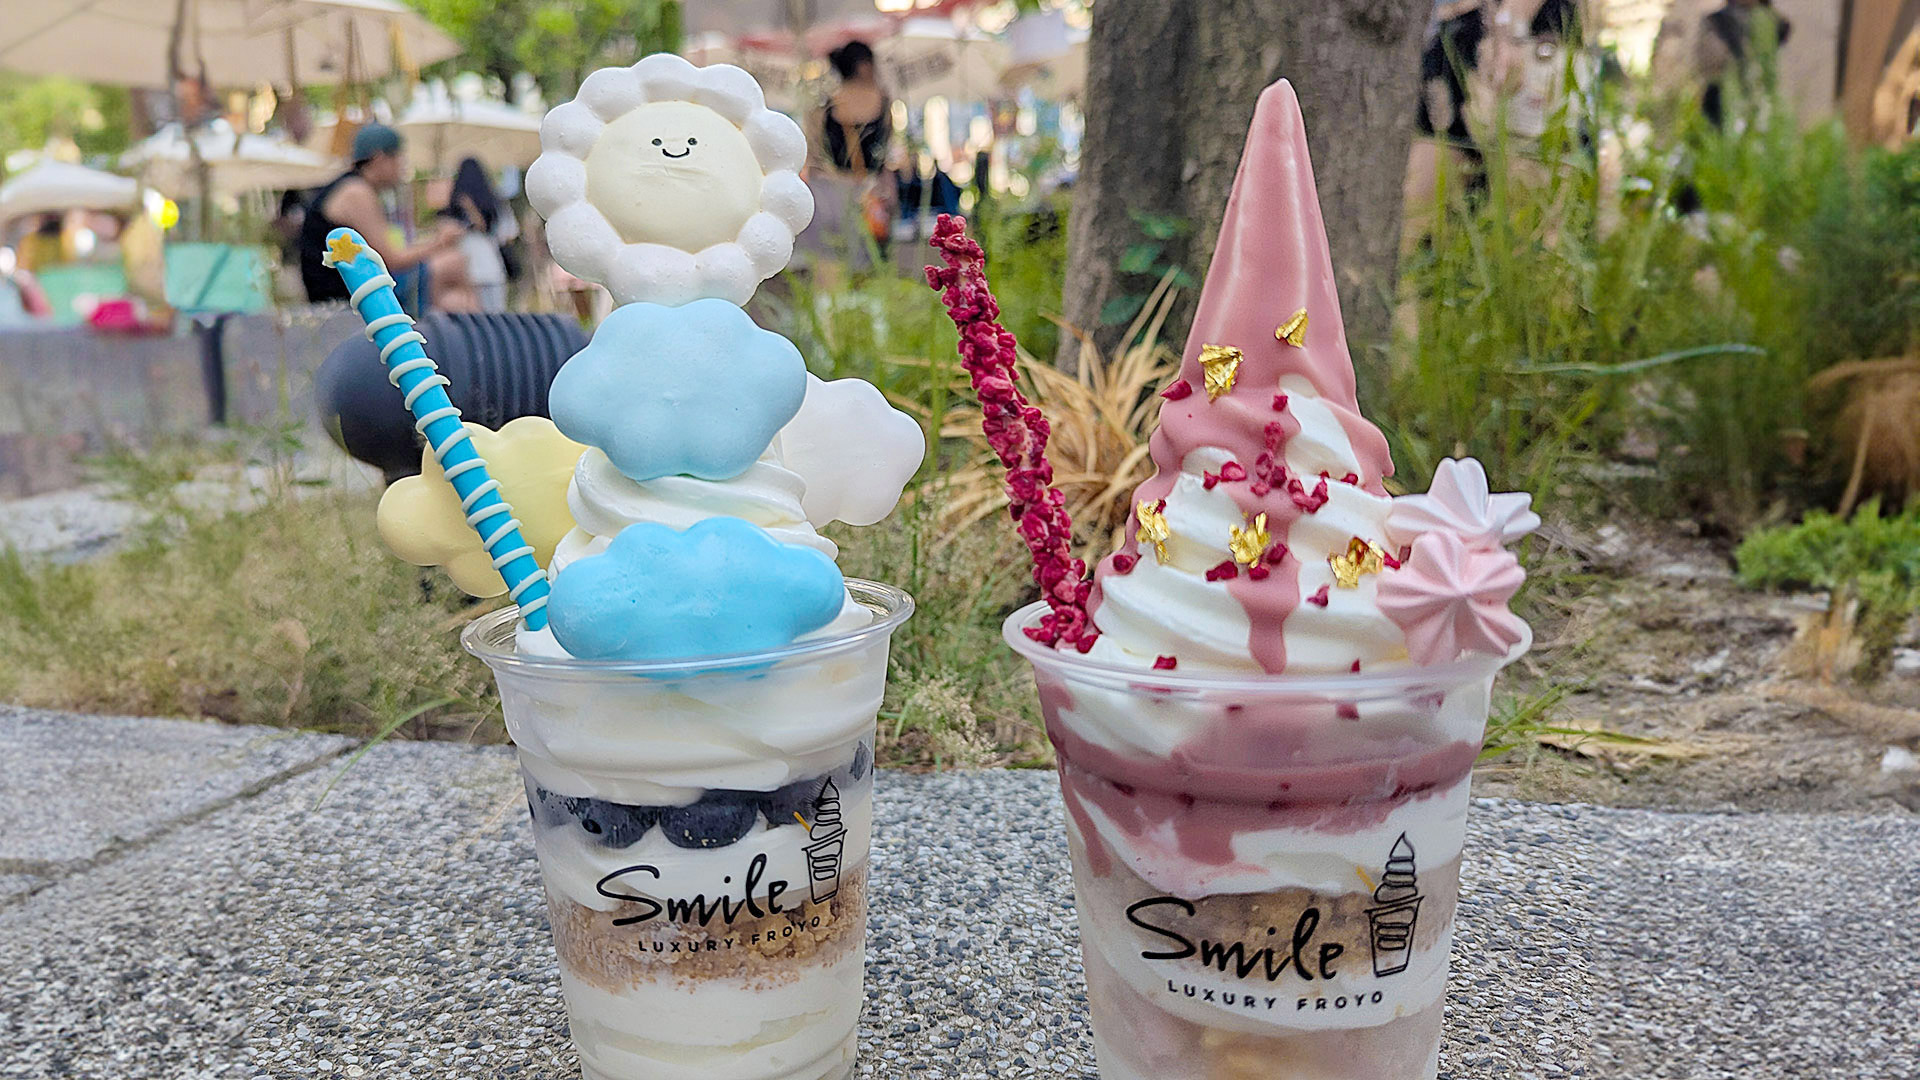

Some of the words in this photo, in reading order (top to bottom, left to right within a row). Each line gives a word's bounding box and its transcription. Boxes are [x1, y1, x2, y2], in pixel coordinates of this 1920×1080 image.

[595, 853, 788, 927] Smile
[638, 937, 735, 953] LUXURY
[751, 915, 821, 946] FROYO
[1125, 896, 1344, 982] Smile
[1167, 979, 1277, 1010] LUXURY
[1297, 990, 1384, 1011] FROYO
